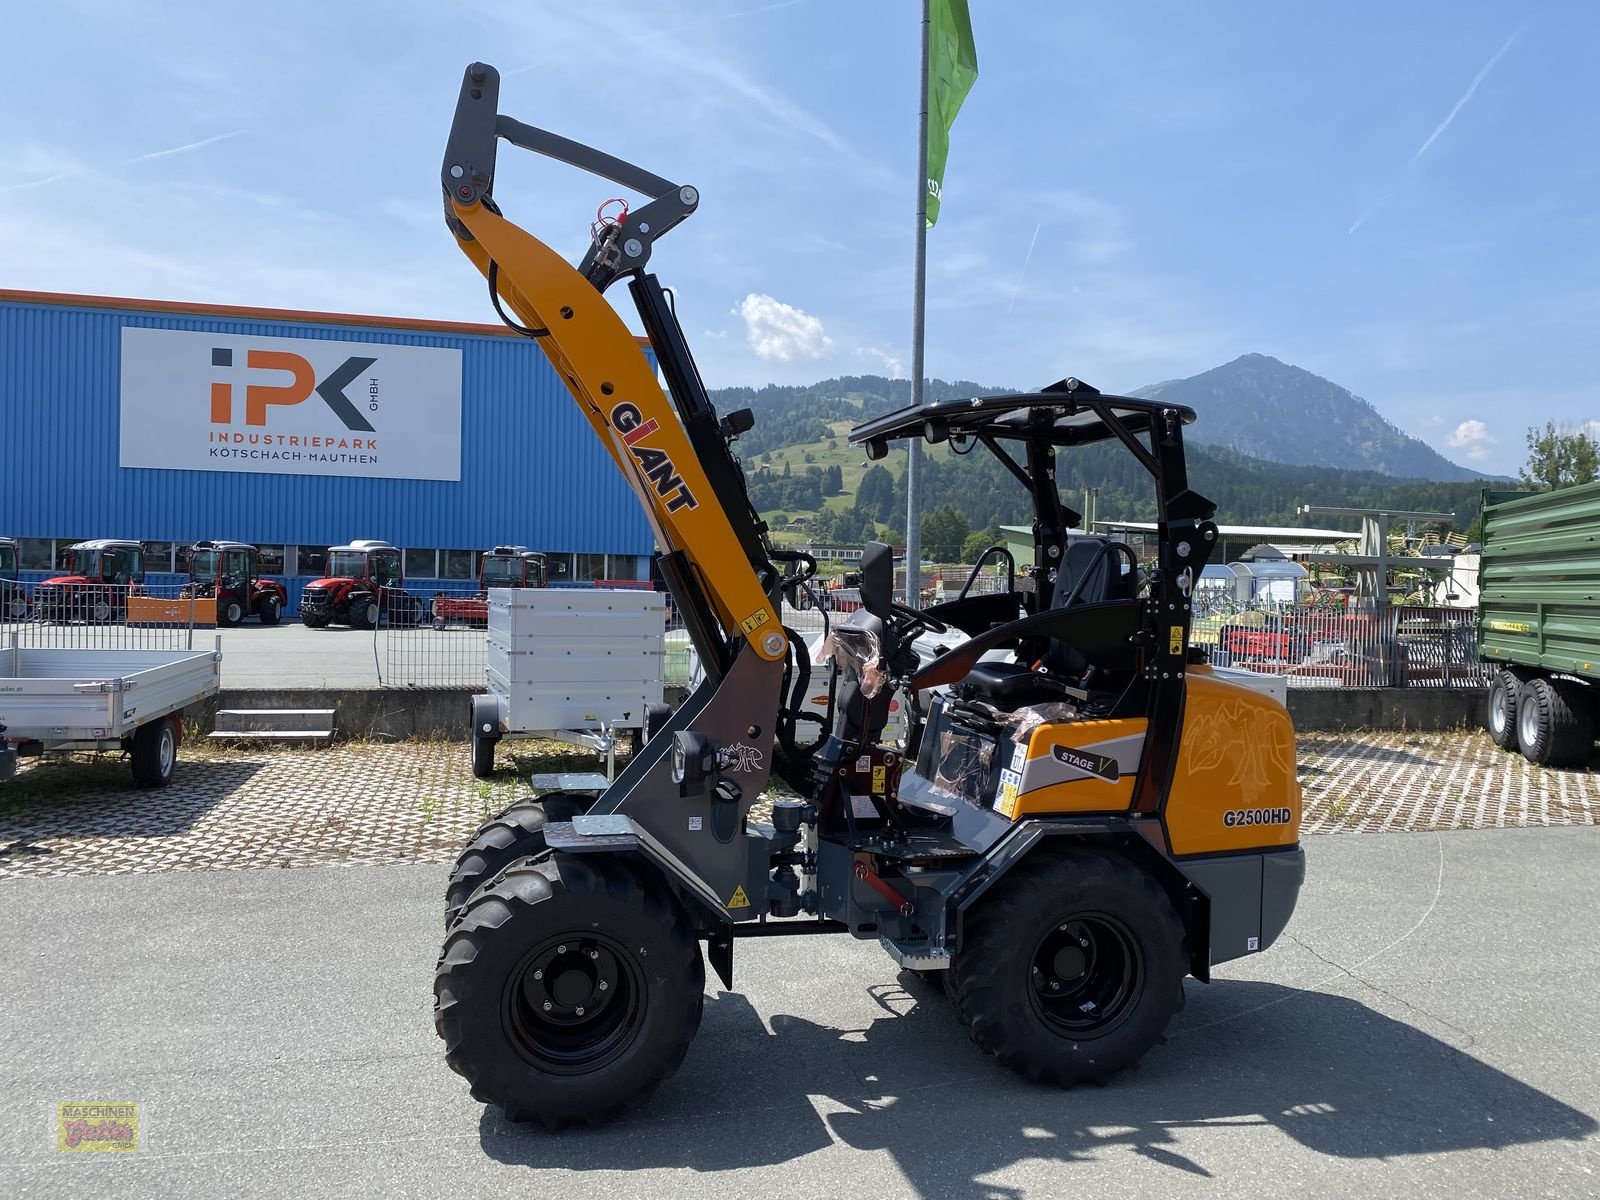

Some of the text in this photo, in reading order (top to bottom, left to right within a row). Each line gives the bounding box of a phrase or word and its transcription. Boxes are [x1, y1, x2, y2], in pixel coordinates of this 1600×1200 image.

[369, 378, 379, 411] GMBH
[210, 431, 378, 450] INDUSTRIEPARK
[210, 448, 378, 464] KÖTSCHACH-MAUTHEN
[610, 401, 699, 514] GIANT
[1061, 752, 1116, 773] STAGE V
[1223, 807, 1292, 828] G2500HD
